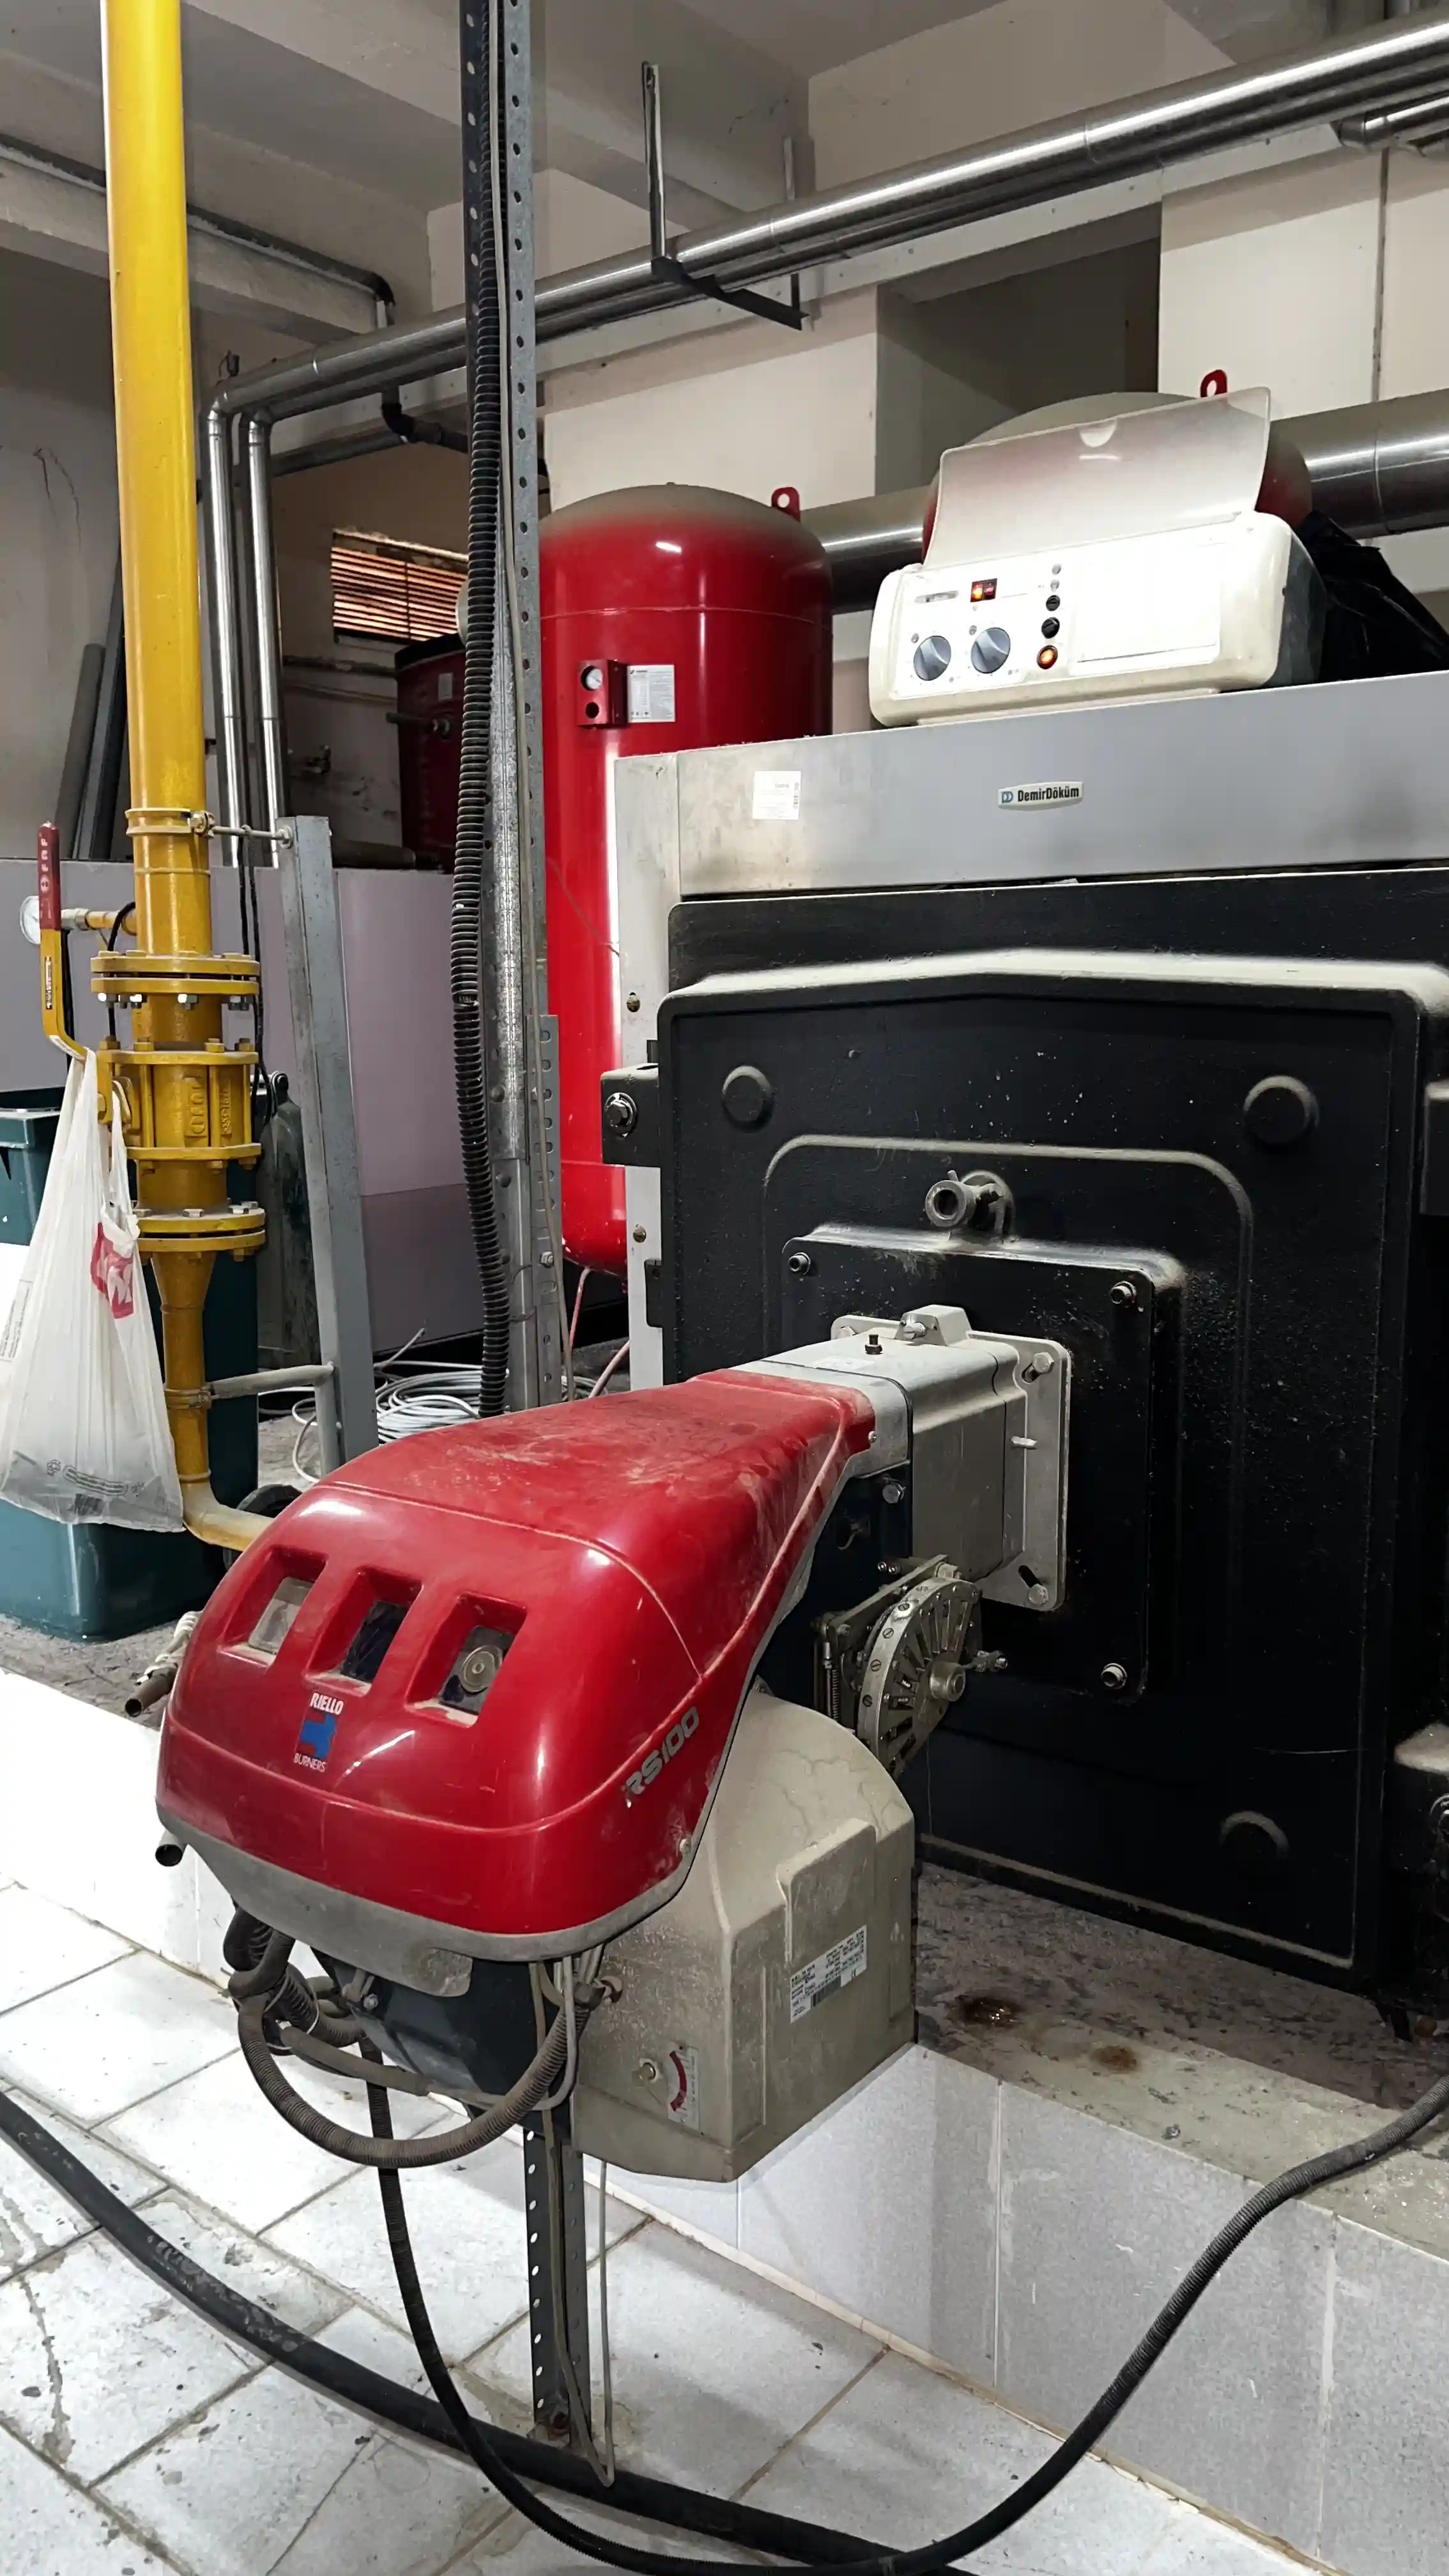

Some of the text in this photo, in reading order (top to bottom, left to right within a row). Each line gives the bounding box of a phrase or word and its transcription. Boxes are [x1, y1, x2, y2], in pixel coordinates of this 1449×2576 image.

[1017, 786, 1079, 802] DemirDöküm
[310, 1692, 344, 1715] RIELLO
[293, 1752, 326, 1772] BURNERS
